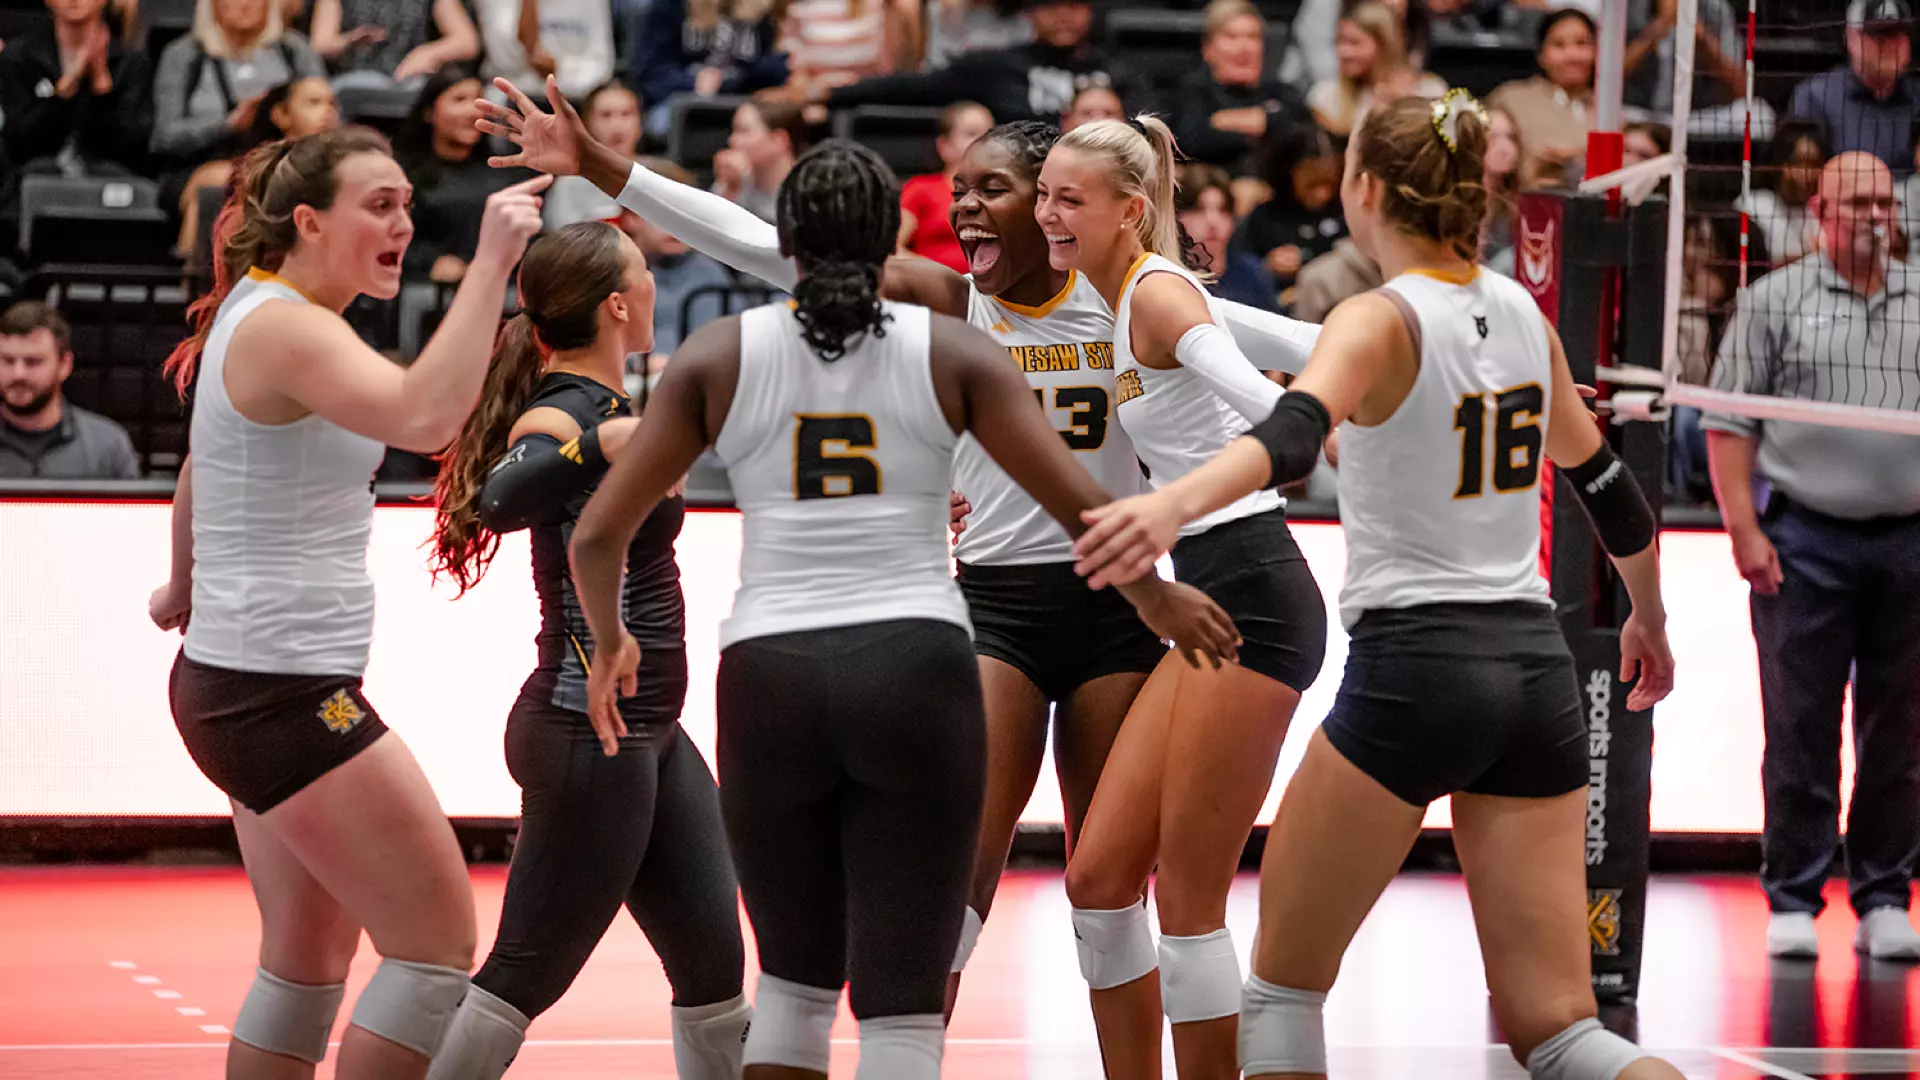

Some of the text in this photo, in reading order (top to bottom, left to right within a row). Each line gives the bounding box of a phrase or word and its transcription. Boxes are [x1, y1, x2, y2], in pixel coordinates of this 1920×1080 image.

[1004, 343, 1080, 372] NESAW
[792, 411, 883, 501] 6
[1452, 380, 1545, 500] 16
[1585, 669, 1612, 757] sports
